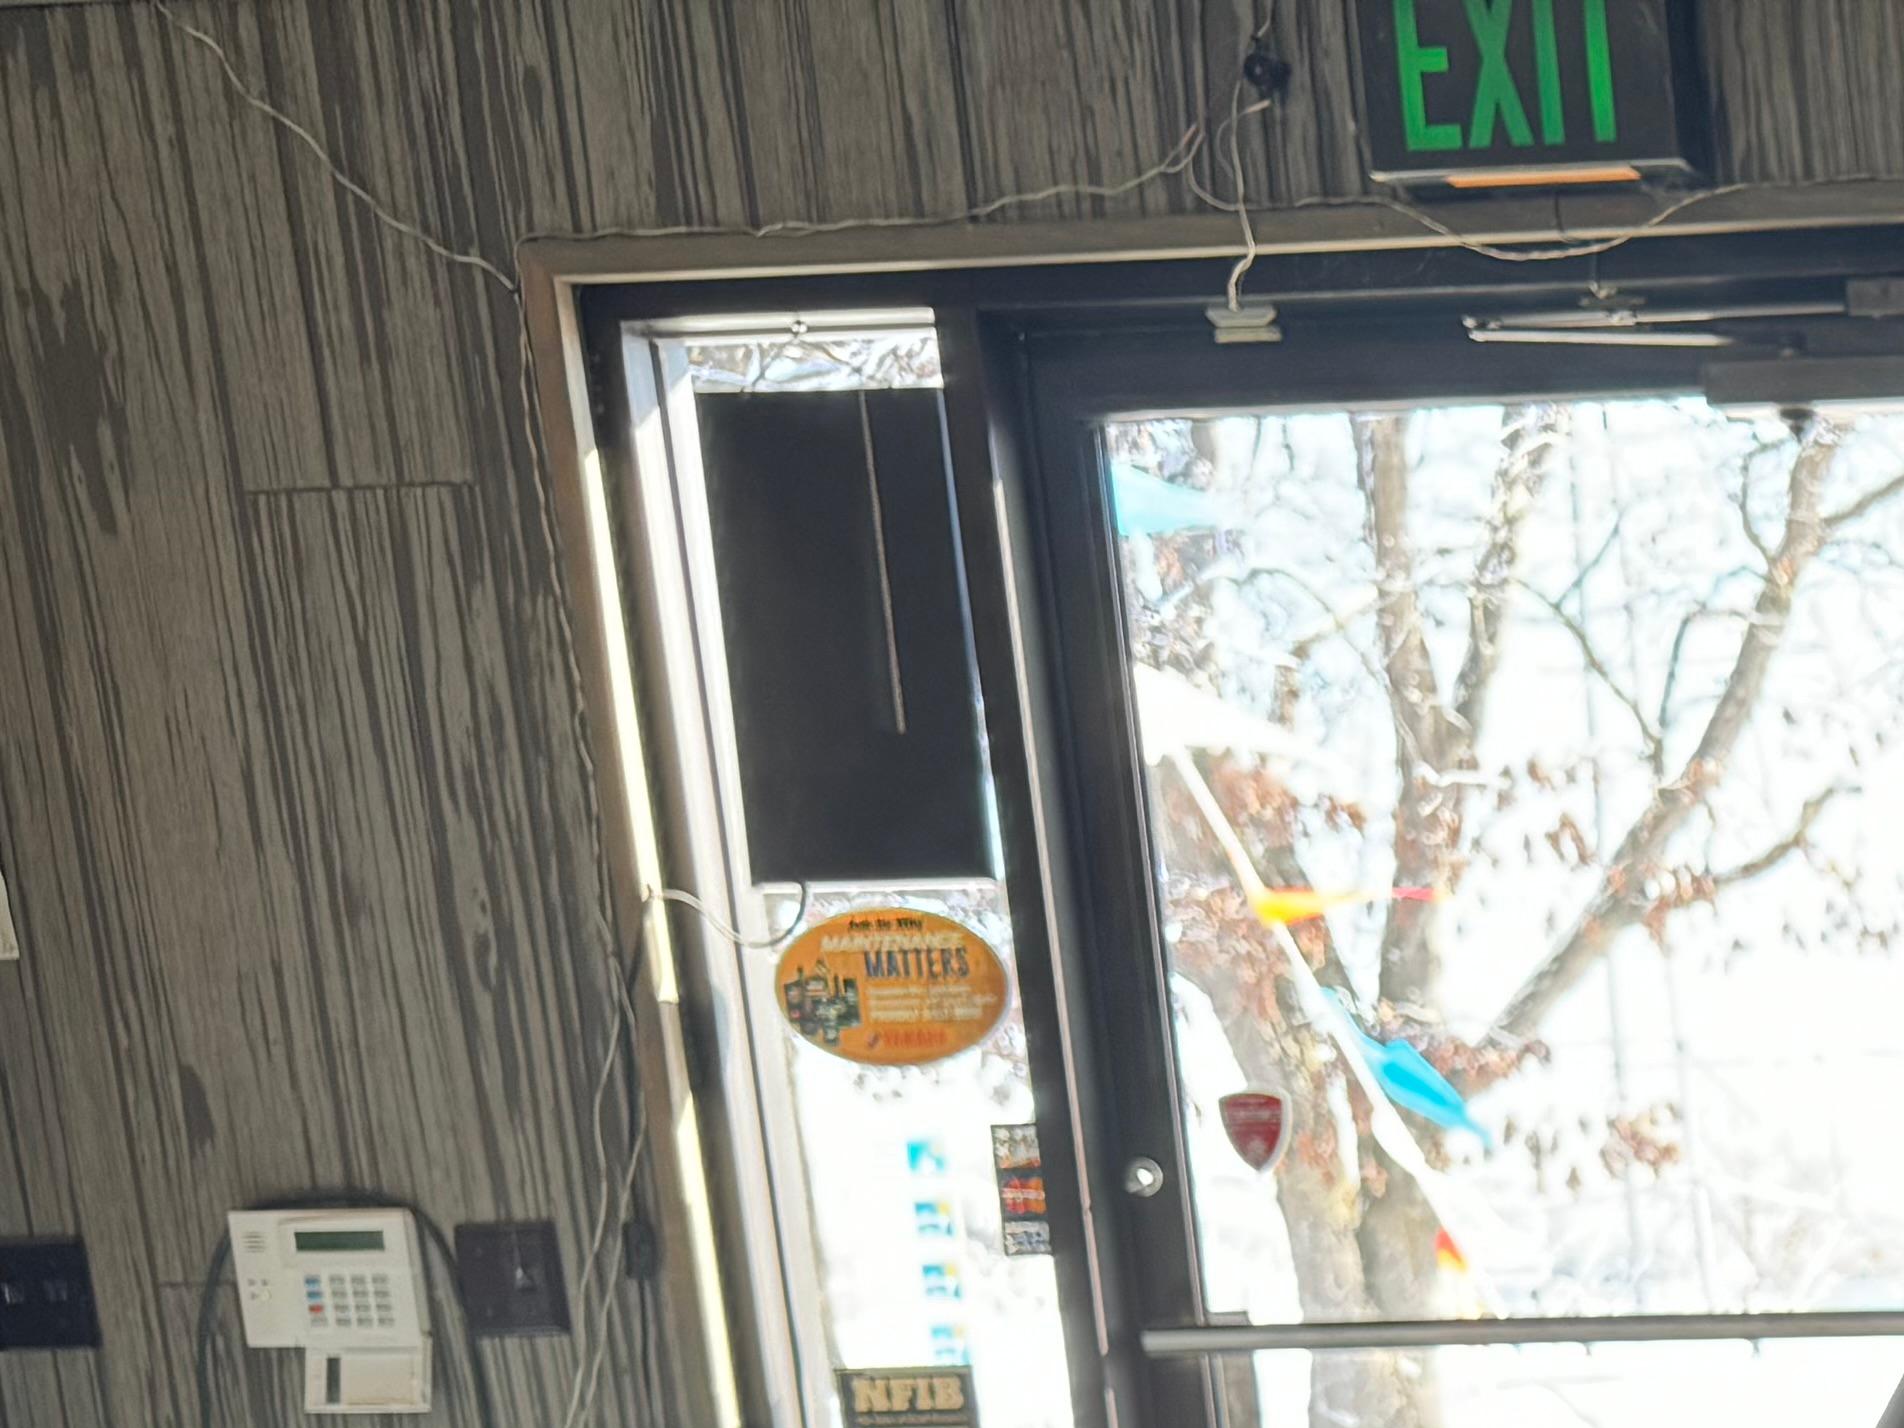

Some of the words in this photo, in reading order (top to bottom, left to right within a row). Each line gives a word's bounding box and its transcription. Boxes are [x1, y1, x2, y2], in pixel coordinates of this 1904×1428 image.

[1394, 0, 1616, 149] EXIT
[864, 947, 970, 979] MATTERS
[852, 1374, 965, 1412] NFIB
